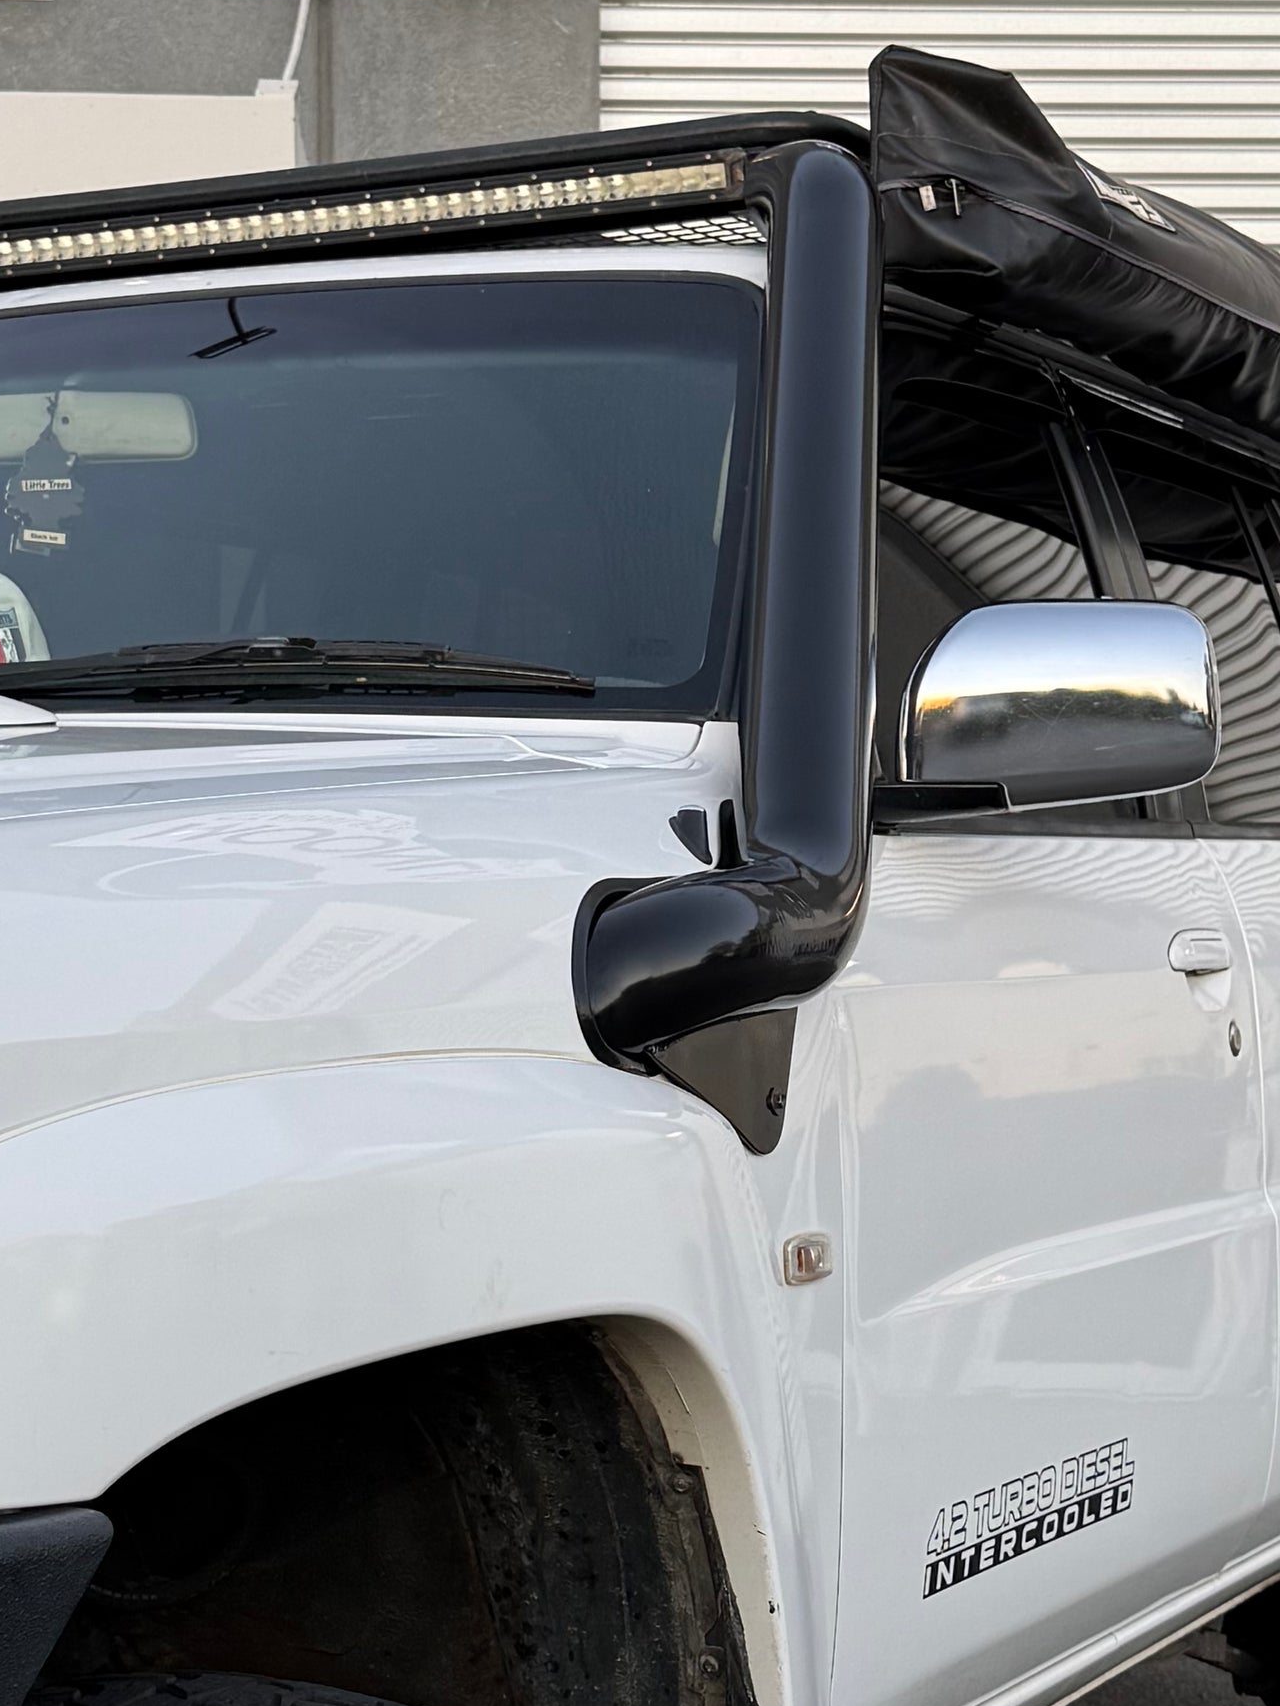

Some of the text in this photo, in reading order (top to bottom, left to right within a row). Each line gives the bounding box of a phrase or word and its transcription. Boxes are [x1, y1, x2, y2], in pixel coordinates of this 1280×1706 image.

[923, 1479, 1133, 1599] INTERCOOLED
[926, 1437, 1135, 1556] 4.2 TURBO DIESEL
